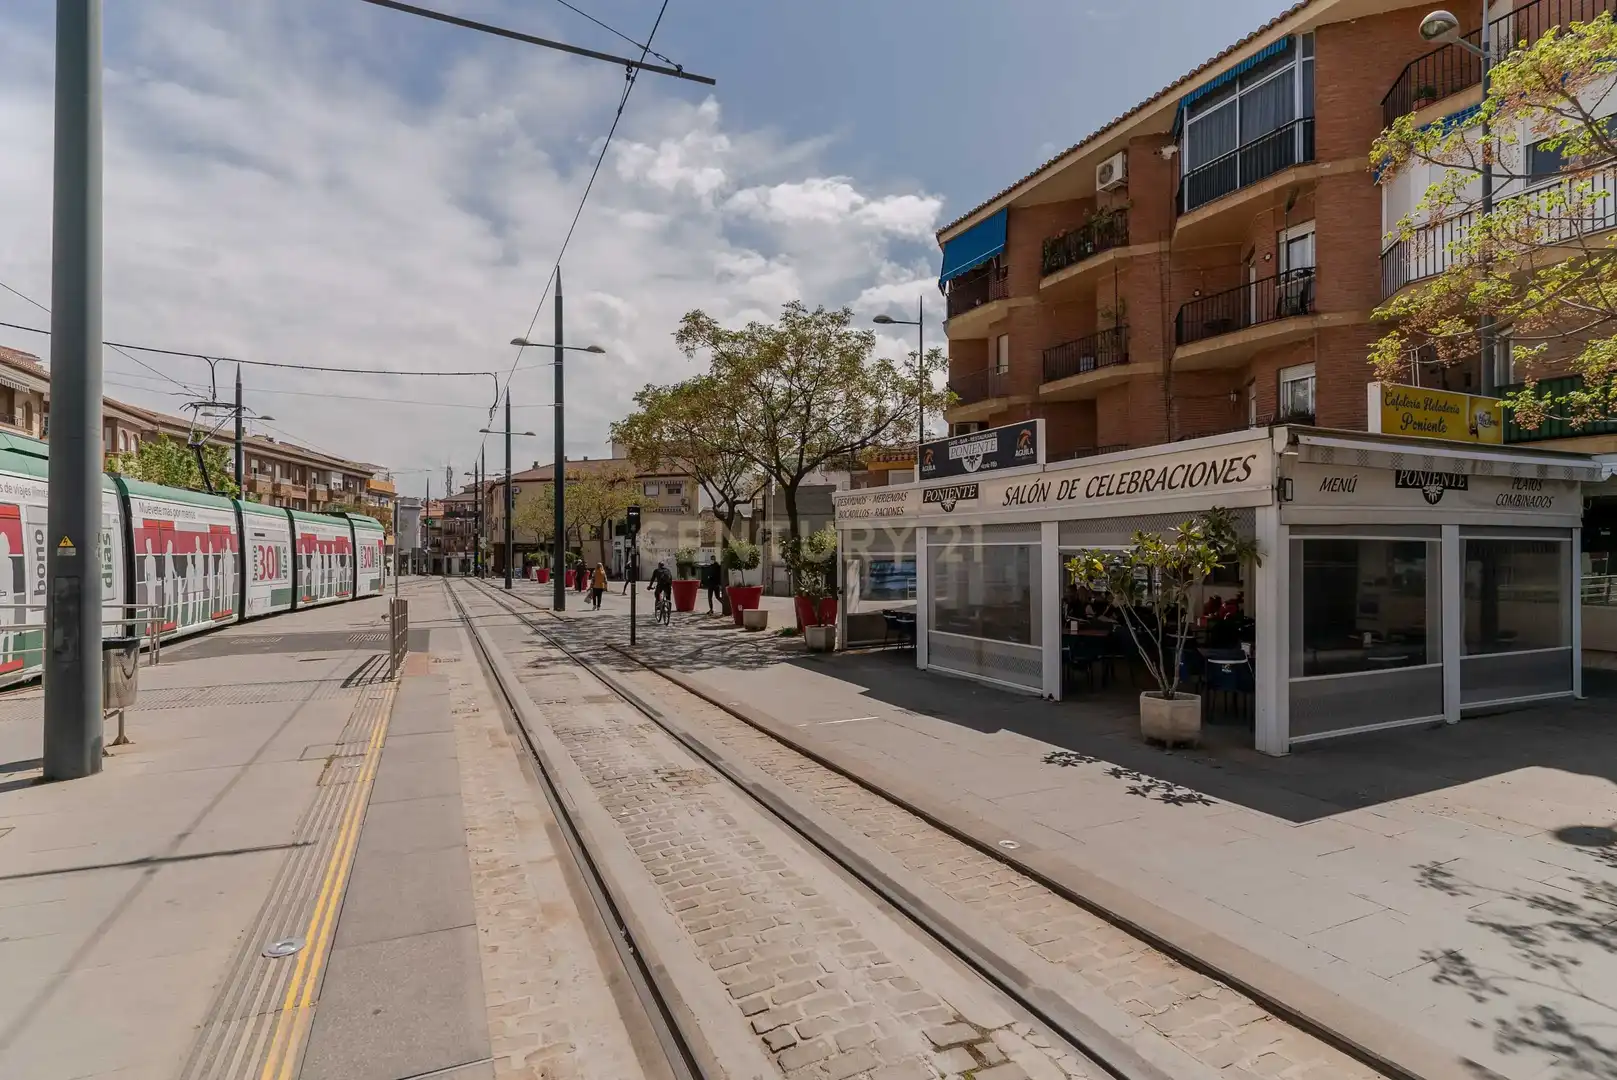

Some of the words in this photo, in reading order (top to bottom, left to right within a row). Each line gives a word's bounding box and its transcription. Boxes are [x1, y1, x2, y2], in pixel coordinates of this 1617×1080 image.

[1400, 412, 1447, 433] Poniente
[950, 440, 997, 458] PONIENTE
[1002, 478, 1051, 506] SALÓN
[1056, 478, 1081, 500] DE
[1085, 454, 1257, 499] CELEBRACIONES
[1319, 475, 1358, 493] MENÚ
[1398, 470, 1466, 488] PONIENTE
[1511, 477, 1544, 492] PLATOS
[4, 482, 13, 494] de
[13, 484, 31, 498] viajes
[924, 484, 977, 502] PONIENTE
[837, 495, 868, 508] DESAYUNOS
[872, 491, 909, 504] MERIENDAS
[1496, 493, 1554, 509] COMBINADOS
[838, 508, 870, 519] BOCADILLOS
[874, 506, 905, 518] RACIONES
[34, 529, 47, 596] bono
[258, 545, 276, 581] 30
